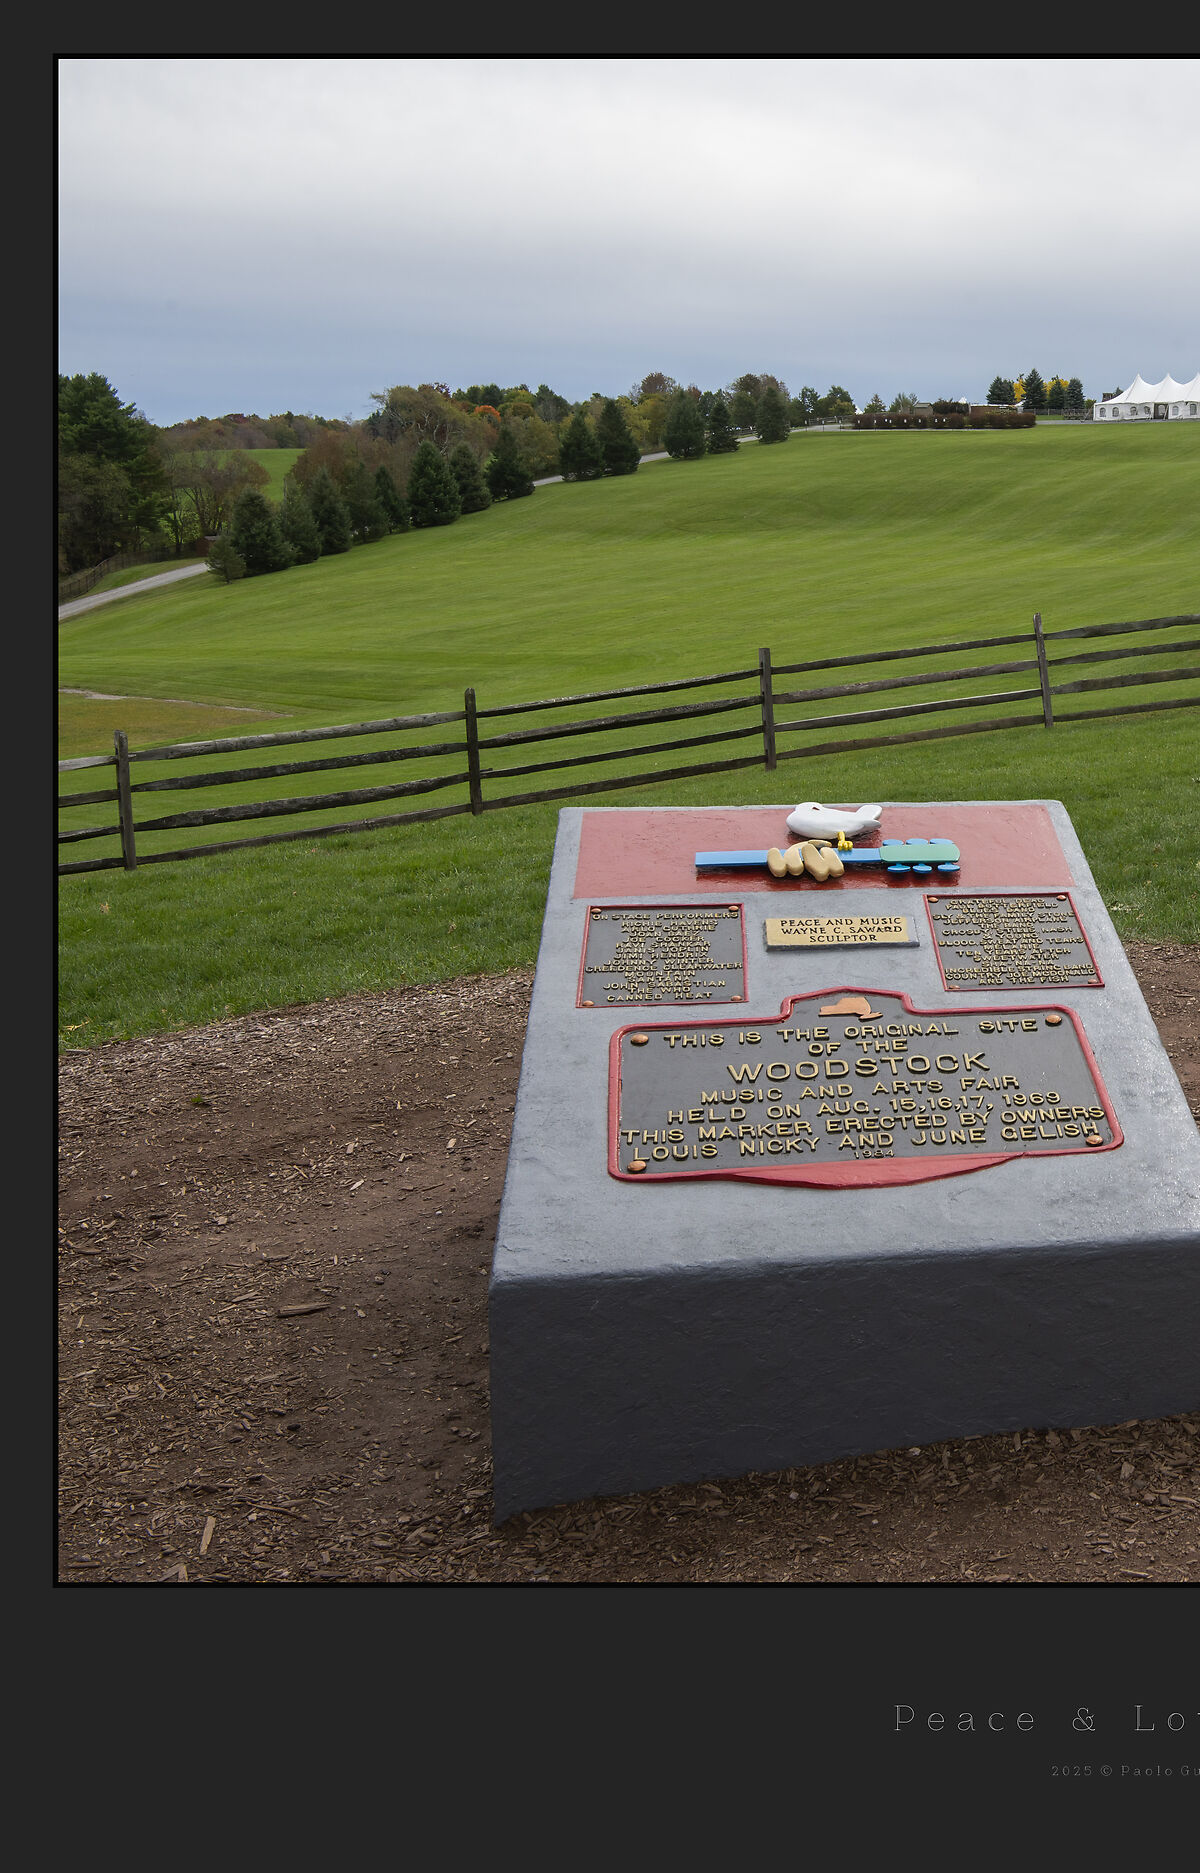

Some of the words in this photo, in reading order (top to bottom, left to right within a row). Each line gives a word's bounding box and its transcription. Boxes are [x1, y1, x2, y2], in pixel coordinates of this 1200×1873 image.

[656, 911, 739, 919] PERFORMERS
[1038, 910, 1075, 918] STONE
[780, 919, 820, 927] PEACE
[826, 918, 854, 926] AND
[860, 917, 902, 925] MUSIC
[781, 927, 826, 935] WAYNE
[849, 925, 903, 934] SAWARD
[809, 934, 878, 943] SCULPTOR
[1046, 936, 1084, 944] TEARS
[651, 940, 711, 948] SHANKAR
[983, 943, 1039, 951] MELANIE
[662, 945, 709, 953] JOPLIN
[651, 951, 708, 959] HENDRIX
[973, 954, 1059, 962] SWEETWATER
[664, 957, 714, 965] WINTER
[585, 965, 658, 973] CREEDENCE
[663, 962, 742, 971] CLEARWATER
[945, 966, 1016, 974] INCREDIBLE
[624, 970, 696, 978] MOUNTAIN
[945, 972, 1002, 980] COUNTRY
[1040, 975, 1069, 983] FISH
[603, 982, 639, 990] JOHN
[607, 993, 663, 1002] CANNED
[675, 991, 713, 999] HEAT
[664, 1033, 725, 1047] THIS
[739, 1031, 762, 1044] IS
[777, 1026, 830, 1042] THE
[844, 1022, 959, 1038] ORIGINAL
[979, 1018, 1038, 1033] SITE
[808, 1042, 841, 1057] OF
[856, 1038, 908, 1054] THE
[727, 1051, 990, 1083] WOODSTOCK
[701, 1088, 783, 1105] MUSIC
[800, 1084, 853, 1100] AND
[872, 1079, 943, 1095] ARTS
[960, 1075, 1020, 1091] FAIR
[667, 1107, 746, 1124] HELD
[767, 1103, 801, 1119] ON
[816, 1099, 880, 1117] AUG.
[1002, 1091, 1061, 1106] 1969
[621, 1128, 685, 1145] THIS
[699, 1120, 813, 1141] MARKER
[825, 1113, 948, 1133] ERECTED
[959, 1111, 991, 1126] BY
[1000, 1105, 1105, 1124] OWNERS
[634, 1143, 719, 1162] LOUIS
[740, 1136, 820, 1156] NICKY
[838, 1132, 894, 1151] AND
[911, 1127, 986, 1146] JUNE
[1001, 1120, 1099, 1141] GELISH
[854, 1148, 895, 1158] 1984
